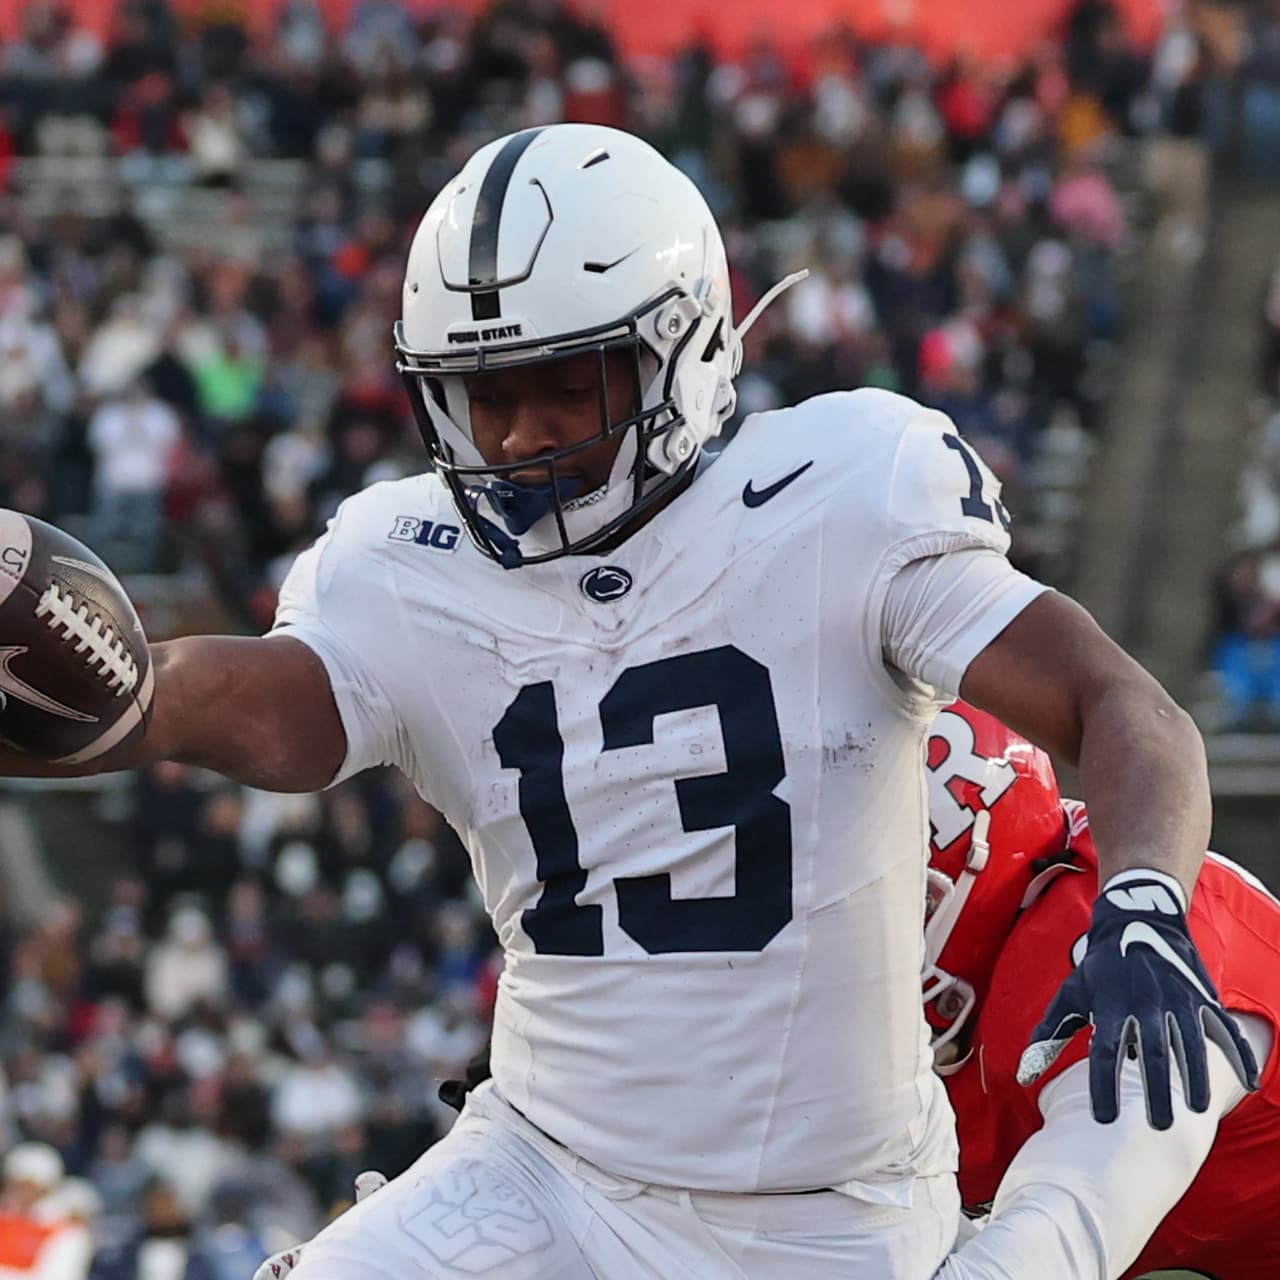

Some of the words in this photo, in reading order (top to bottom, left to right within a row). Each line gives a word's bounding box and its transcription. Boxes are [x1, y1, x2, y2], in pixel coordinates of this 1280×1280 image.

[481, 323, 522, 341] STATE
[941, 431, 1011, 532] 1
[491, 643, 794, 958] 13
[925, 709, 1020, 852] R
